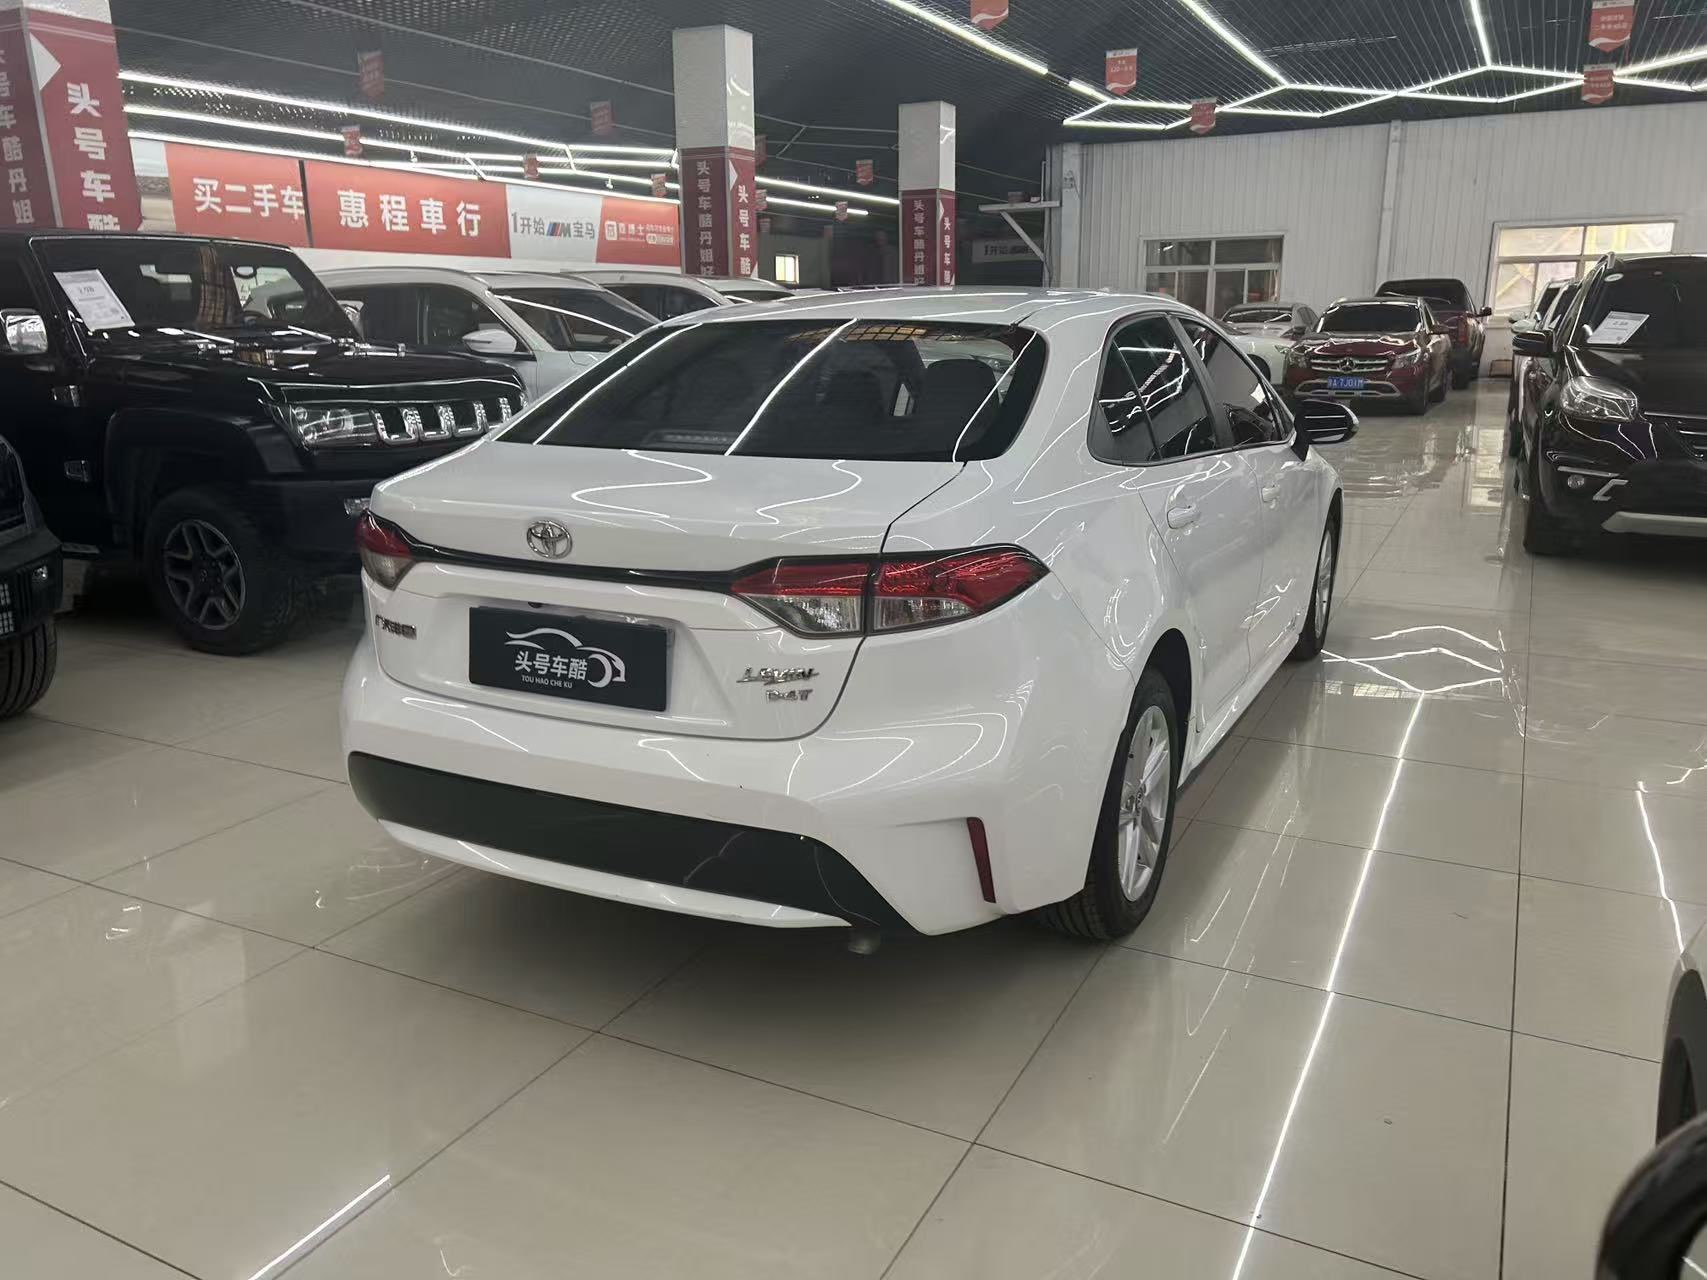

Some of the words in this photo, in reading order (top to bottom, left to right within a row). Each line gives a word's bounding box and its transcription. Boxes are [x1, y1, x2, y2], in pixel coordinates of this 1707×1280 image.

[193, 178, 305, 220] 买二手车
[337, 189, 481, 237] 惠程車行
[738, 185, 751, 275] 头号车酷
[515, 650, 588, 681] 头号车酷
[521, 674, 535, 684] TOU
[535, 676, 549, 686] HAO
[550, 679, 562, 688] CHE
[563, 681, 573, 689] KU
